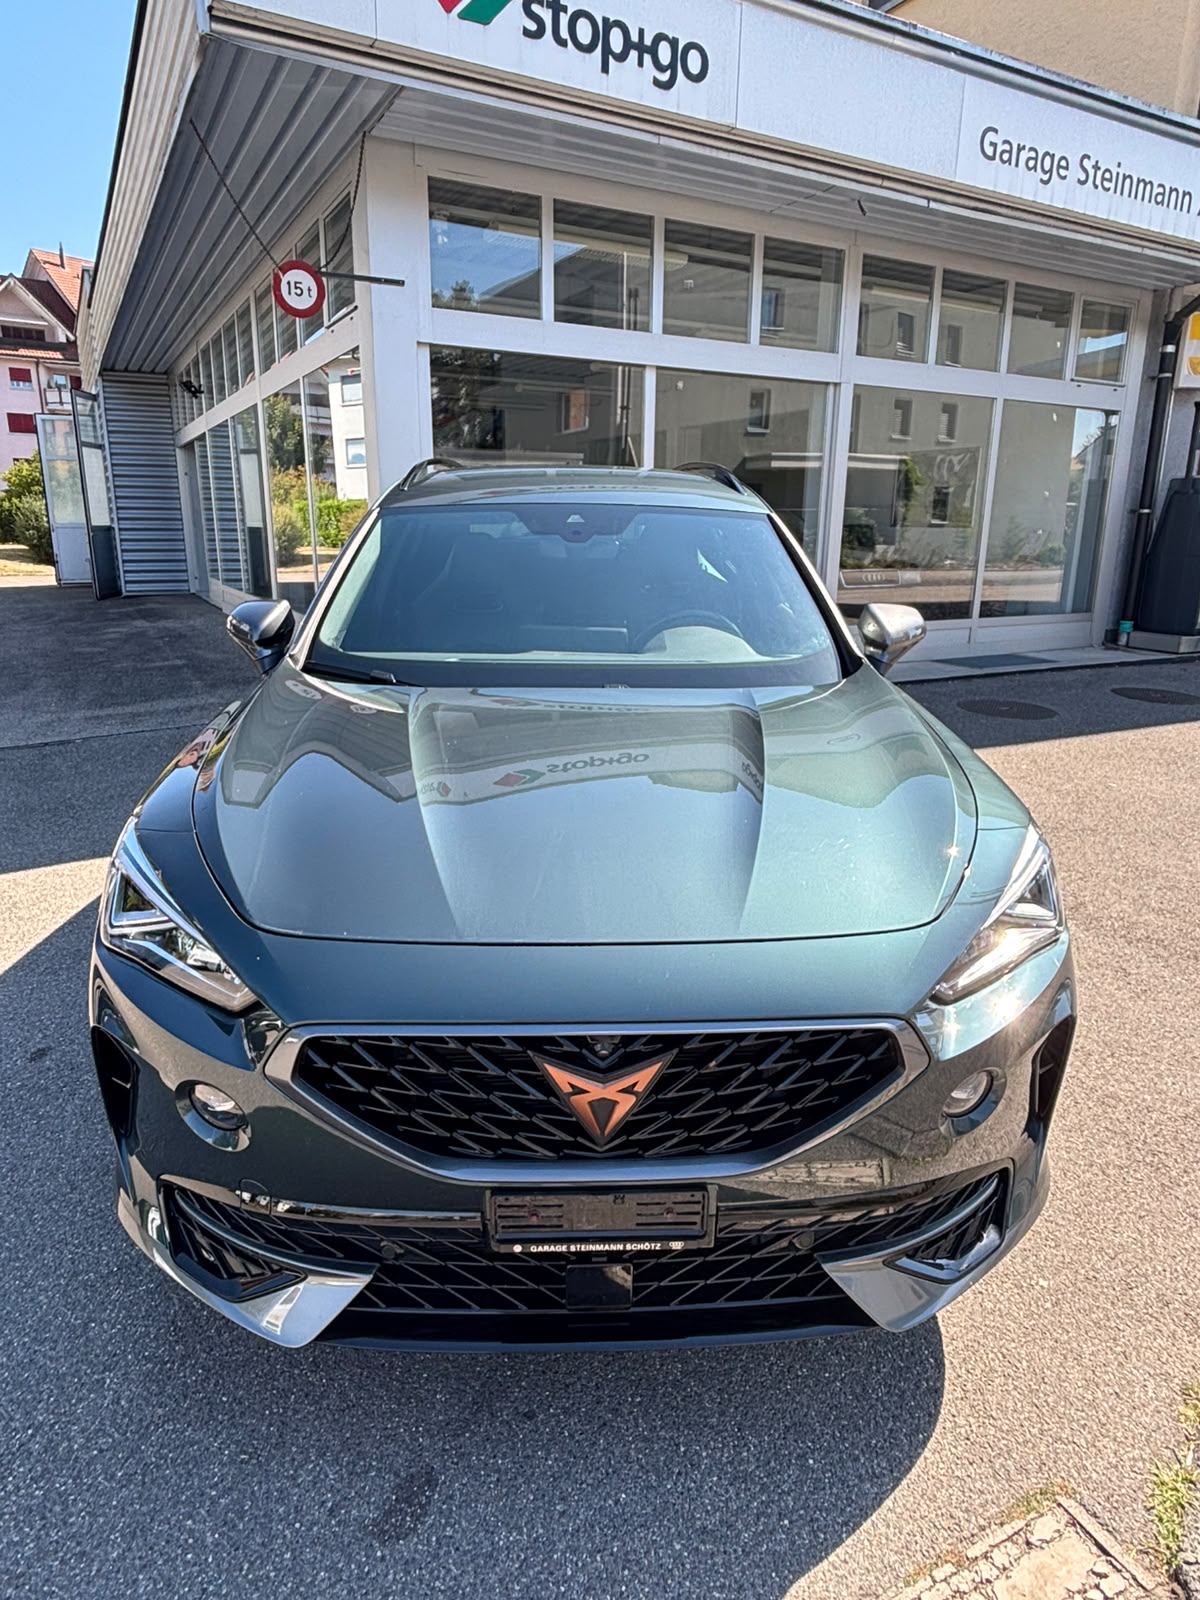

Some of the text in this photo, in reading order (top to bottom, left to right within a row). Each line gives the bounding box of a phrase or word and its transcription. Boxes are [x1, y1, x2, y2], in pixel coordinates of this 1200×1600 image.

[522, 0, 710, 91] stop+go
[979, 126, 1193, 214] Garage Steinmann
[286, 280, 313, 298] 15 t
[530, 1242, 662, 1253] GARAGE STEINMANN SCHÖTZ
